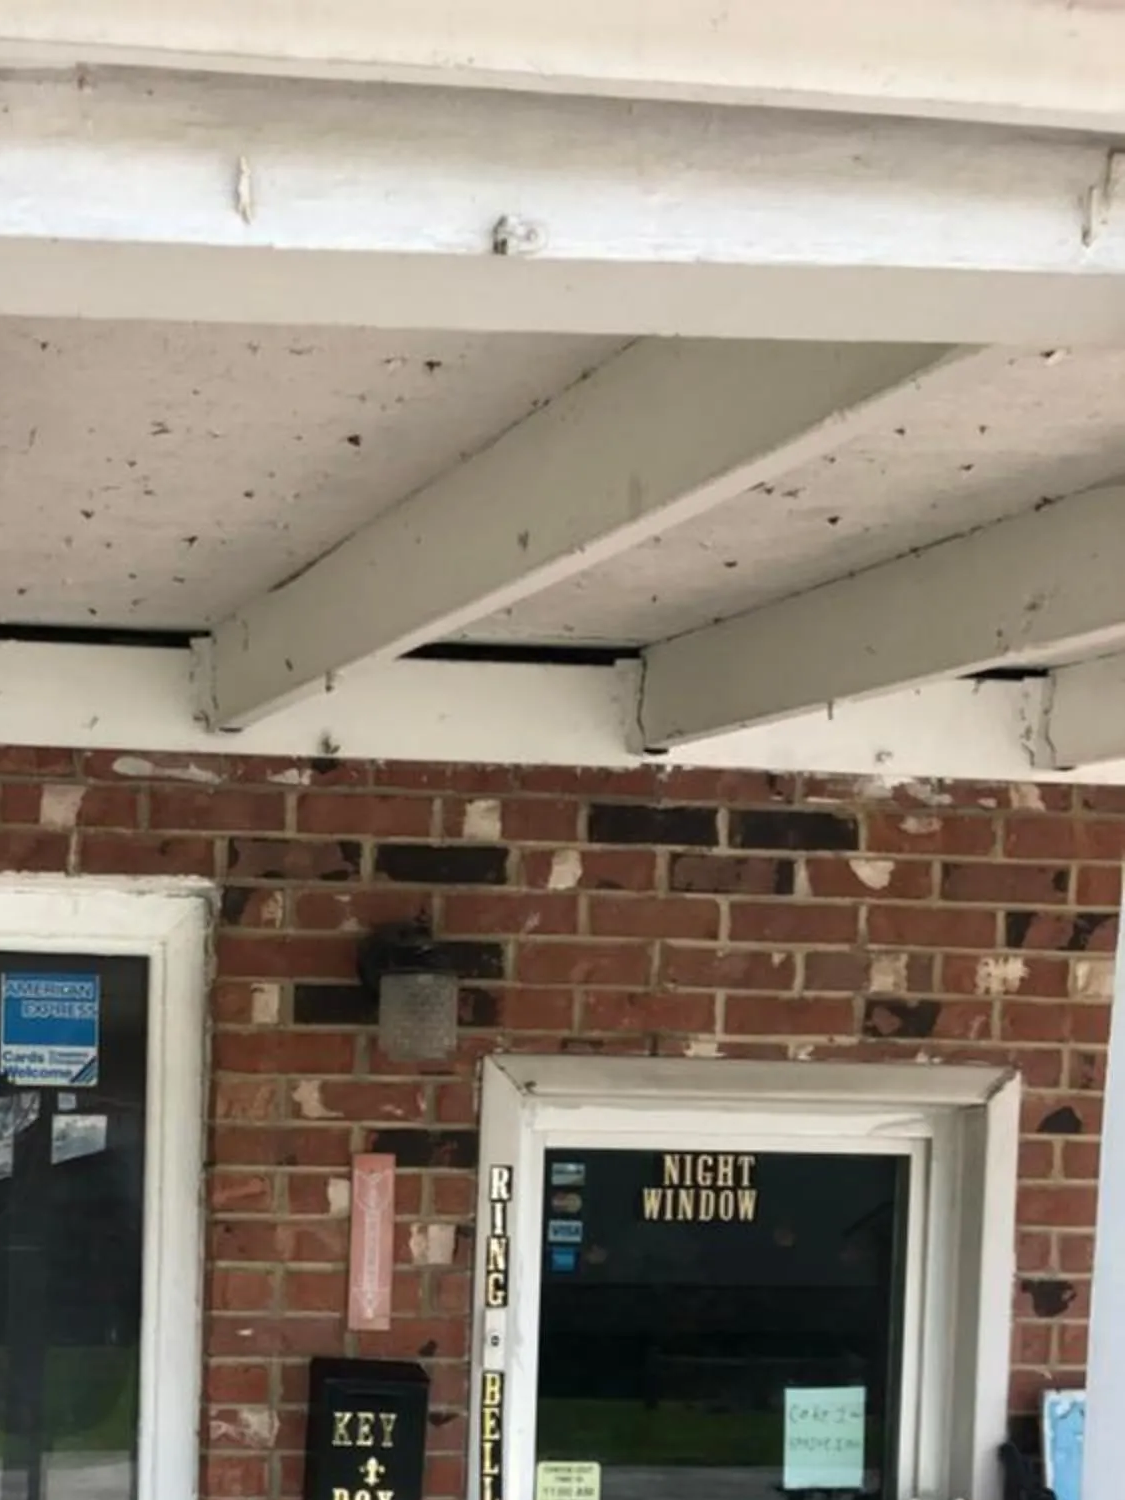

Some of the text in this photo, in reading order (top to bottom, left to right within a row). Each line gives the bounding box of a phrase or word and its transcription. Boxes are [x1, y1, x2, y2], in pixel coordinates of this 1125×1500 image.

[5, 980, 93, 999] AMERICAN
[21, 1001, 96, 1018] EXPRESS
[3, 1050, 45, 1063] Cards
[663, 1153, 756, 1187] NIGHT
[642, 1187, 758, 1222] WINDOW
[487, 1166, 511, 1307] RING
[332, 1411, 398, 1447] KEY
